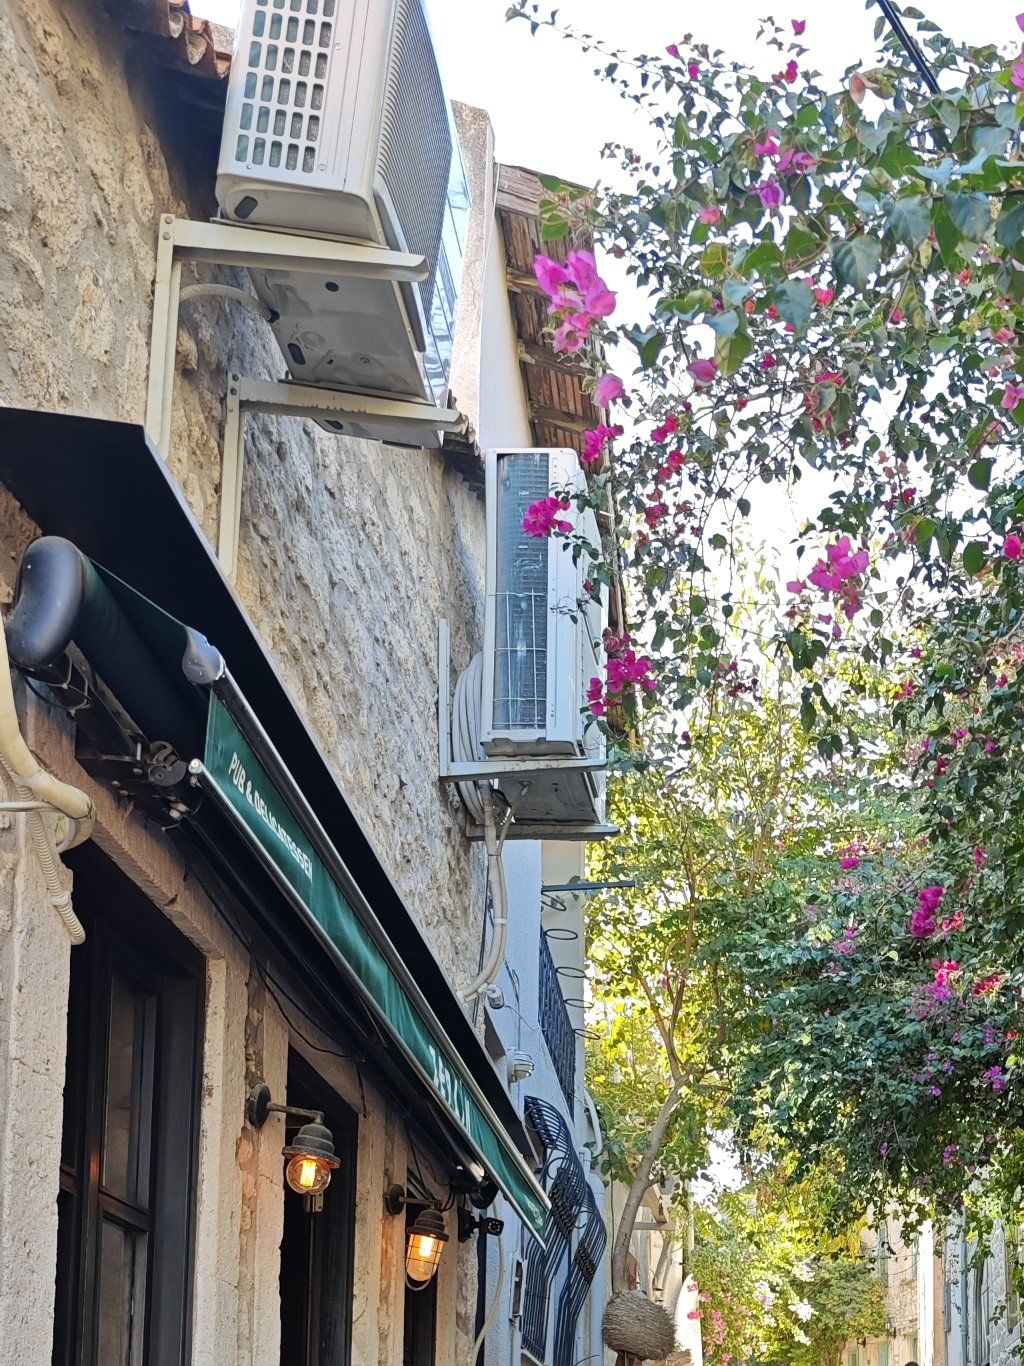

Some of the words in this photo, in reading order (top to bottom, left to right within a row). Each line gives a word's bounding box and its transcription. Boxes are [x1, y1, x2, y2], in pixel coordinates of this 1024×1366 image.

[229, 752, 246, 794] PUB
[245, 780, 254, 807] &
[254, 790, 313, 884] DELICATESSEN
